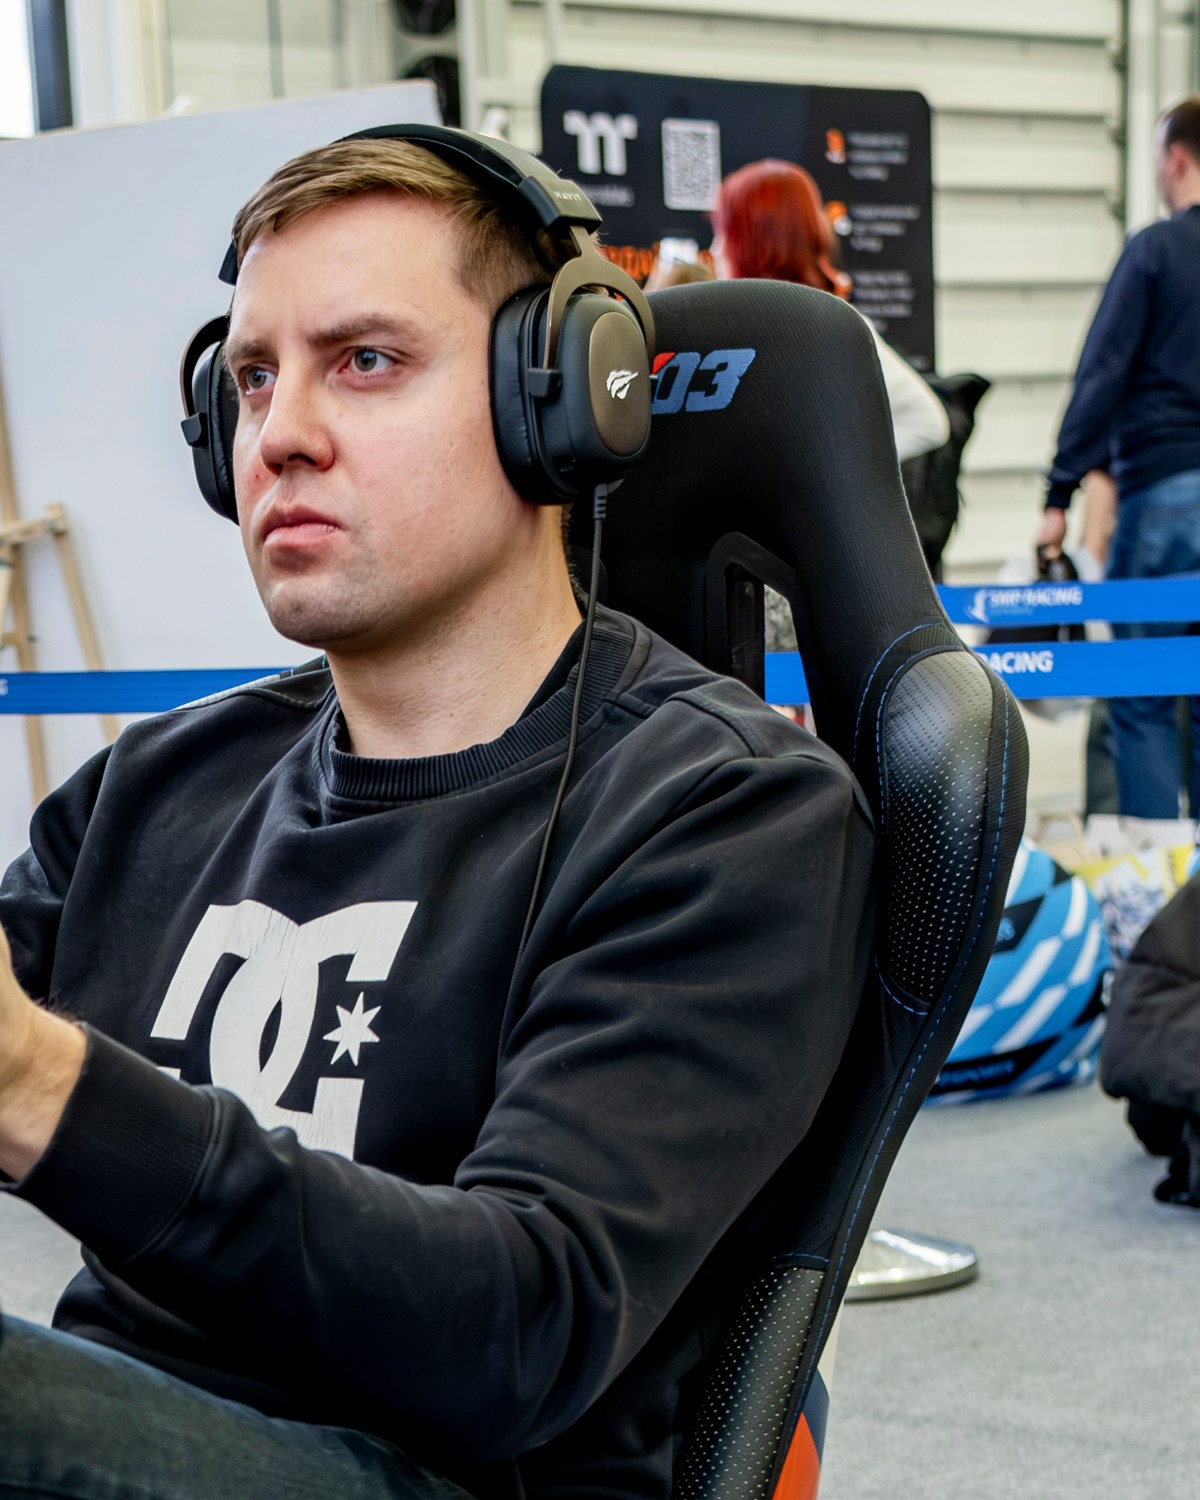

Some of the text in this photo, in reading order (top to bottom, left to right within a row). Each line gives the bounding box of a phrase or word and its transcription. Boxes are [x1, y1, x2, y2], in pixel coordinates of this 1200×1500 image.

[553, 191, 582, 202] HAVIT
[651, 348, 756, 415] 03
[1023, 584, 1084, 607] RACING
